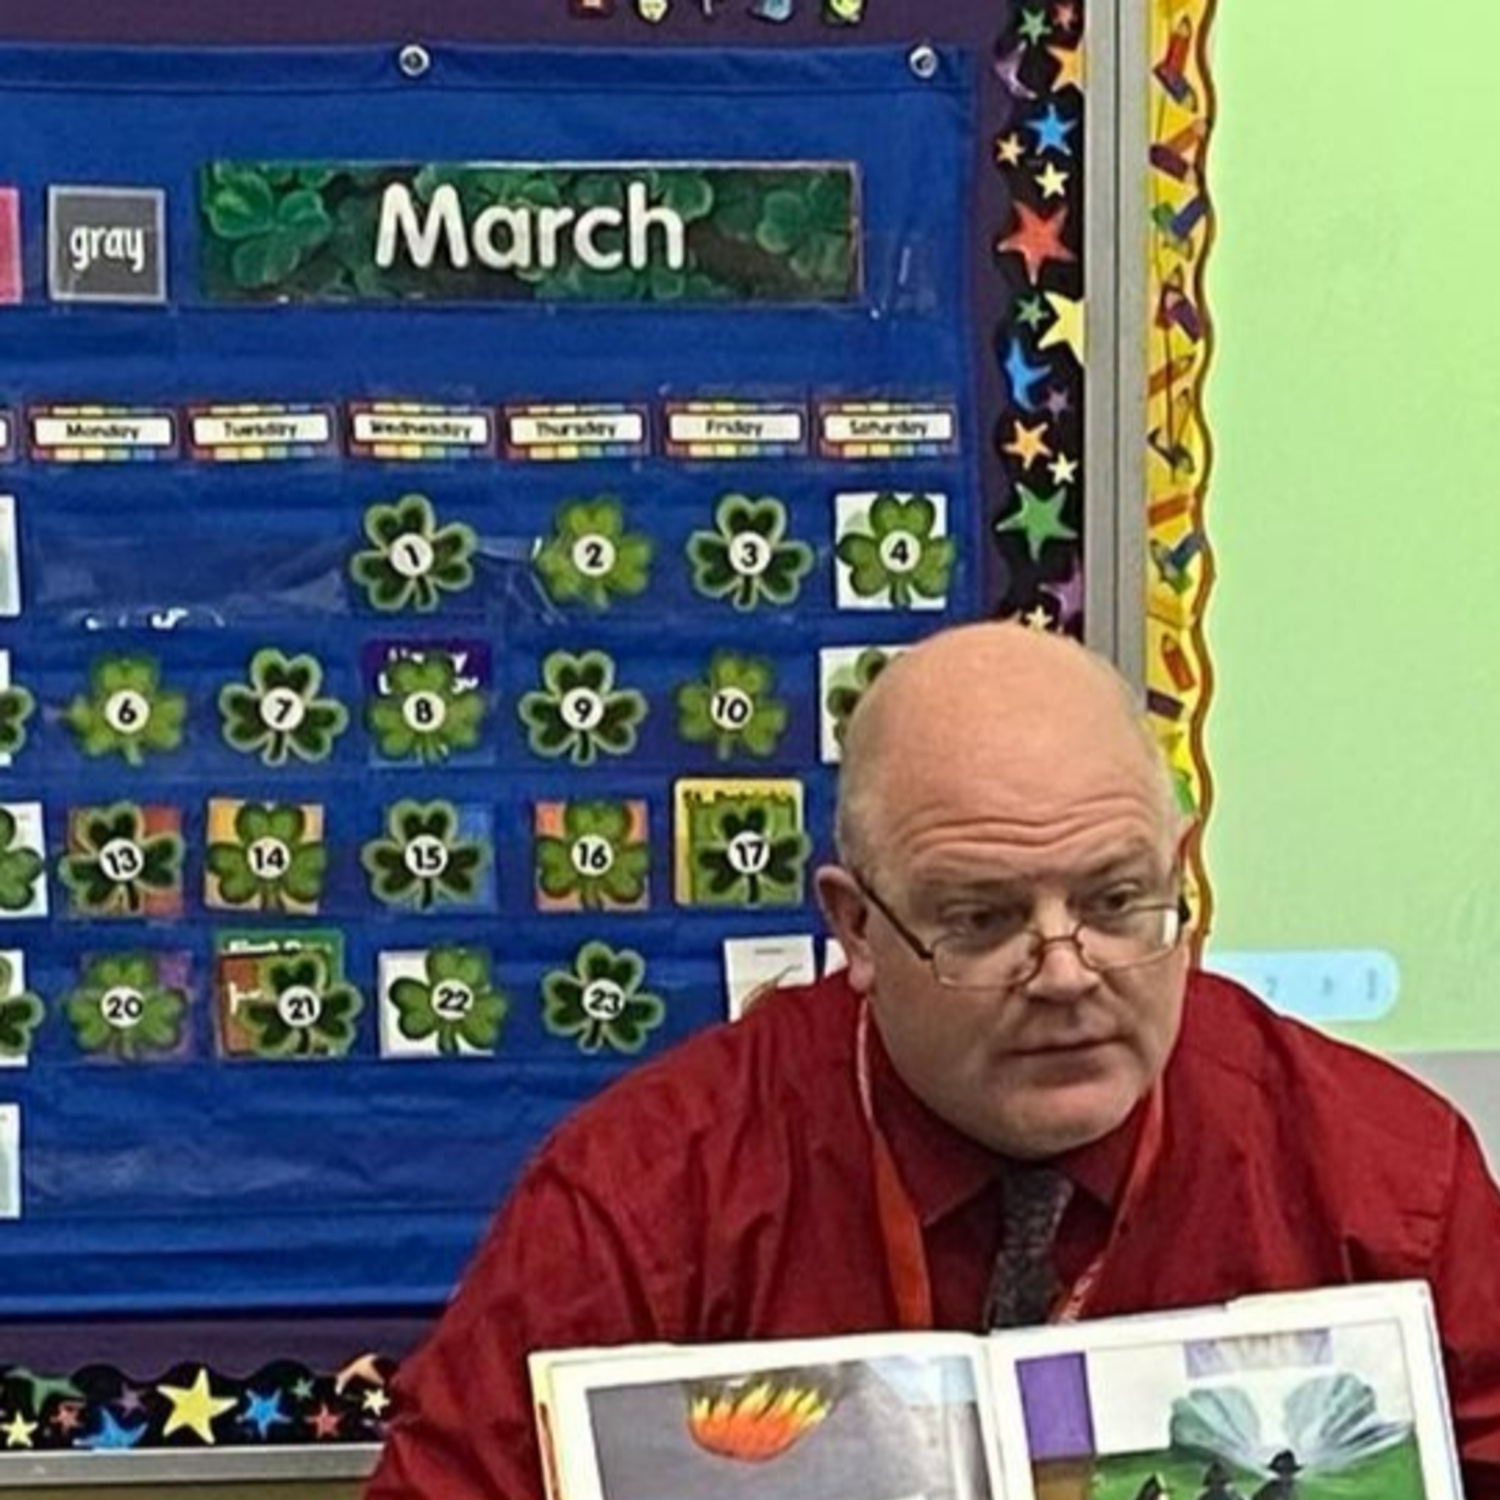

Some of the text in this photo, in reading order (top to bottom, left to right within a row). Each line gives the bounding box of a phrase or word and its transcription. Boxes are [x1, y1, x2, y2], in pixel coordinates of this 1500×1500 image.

[375, 182, 685, 271] March
[70, 224, 144, 273] gray
[66, 422, 140, 440] Monday
[225, 421, 297, 439] Tuesday
[369, 420, 472, 439] Wednesday
[535, 420, 618, 438] Thursday
[706, 419, 764, 437] Friday
[849, 419, 928, 436] Saturday
[404, 544, 421, 568] 1
[585, 543, 603, 568] 2
[740, 542, 758, 568] 3
[890, 540, 909, 564] 4
[118, 699, 137, 724] 6
[274, 699, 292, 722] 7
[415, 698, 434, 723] 8
[574, 698, 592, 721] 9
[716, 695, 749, 723] 10
[105, 847, 138, 873] 13
[253, 846, 285, 870] 14
[412, 845, 442, 870] 15
[578, 842, 608, 870] 16
[734, 842, 765, 868] 17
[107, 996, 142, 1019] 20
[287, 996, 316, 1021] 21
[437, 987, 470, 1013] 22
[589, 988, 621, 1015] 23
